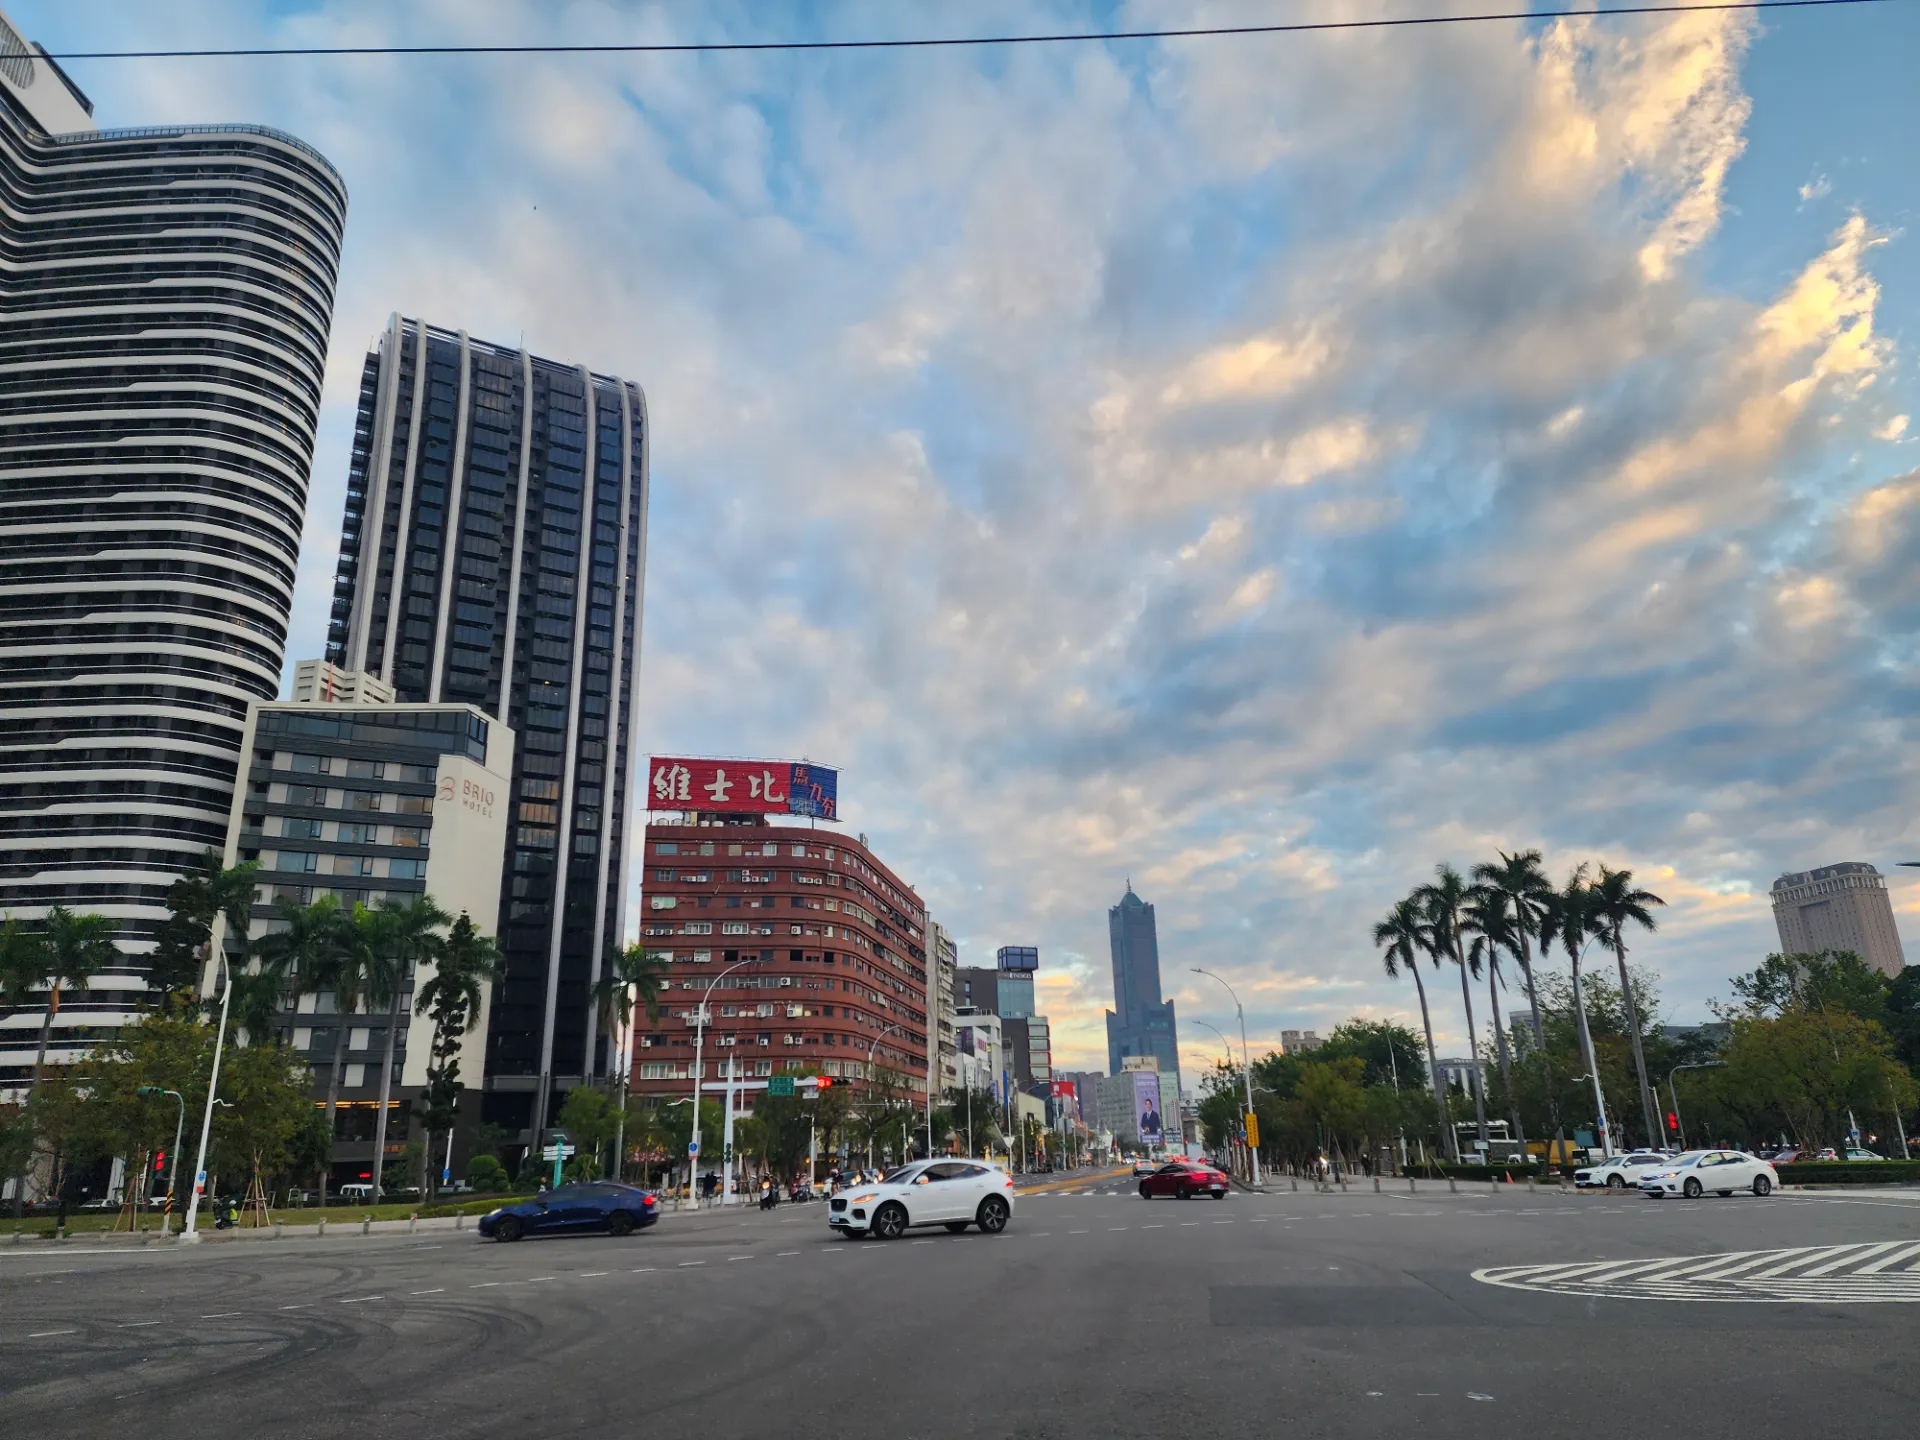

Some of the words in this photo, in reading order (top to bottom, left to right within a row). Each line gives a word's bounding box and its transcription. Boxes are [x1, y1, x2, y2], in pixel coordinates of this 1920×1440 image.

[463, 779, 494, 806] BRIO
[653, 764, 785, 803] 維士比
[792, 766, 835, 817] 馬力夯
[462, 798, 493, 819] HOTEL
